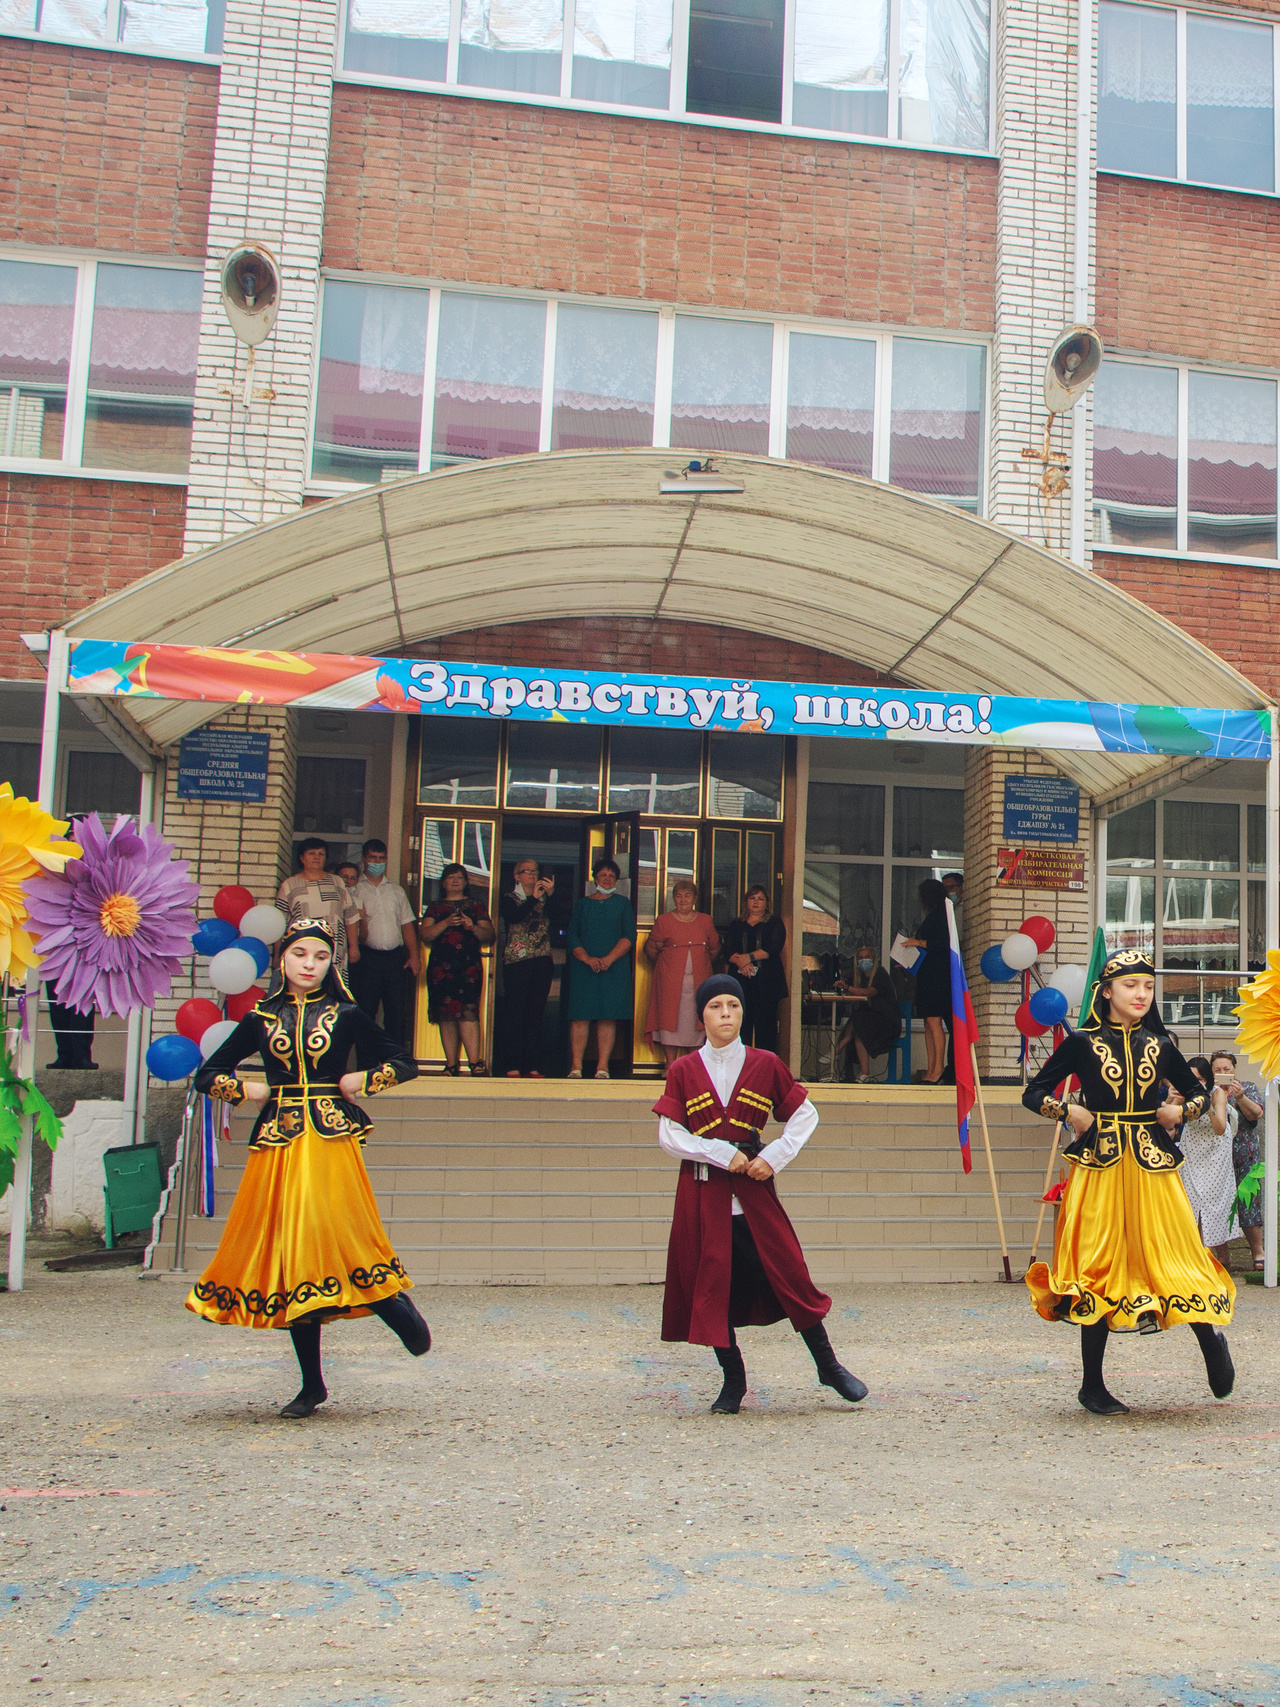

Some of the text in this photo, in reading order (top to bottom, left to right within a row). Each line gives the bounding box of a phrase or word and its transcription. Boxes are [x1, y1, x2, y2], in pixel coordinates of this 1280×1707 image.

[407, 661, 994, 735] Здравствуй, школа!
[206, 760, 239, 769] СРЕДНЯЯ
[180, 768, 266, 780] ОБЩЕОБРАЗОВАТЕЛЬНАЯ
[199, 778, 225, 787] ШКОЛА
[1006, 803, 1077, 814] ОБЩЕОБРАЗОВАТЕЛЬНЭ
[1025, 851, 1077, 860] УЧАСТКОВАЯ
[1018, 859, 1083, 870] ИЗБИРАТЕЛЬНАЯ
[1027, 870, 1073, 878] КОМИССИЯ
